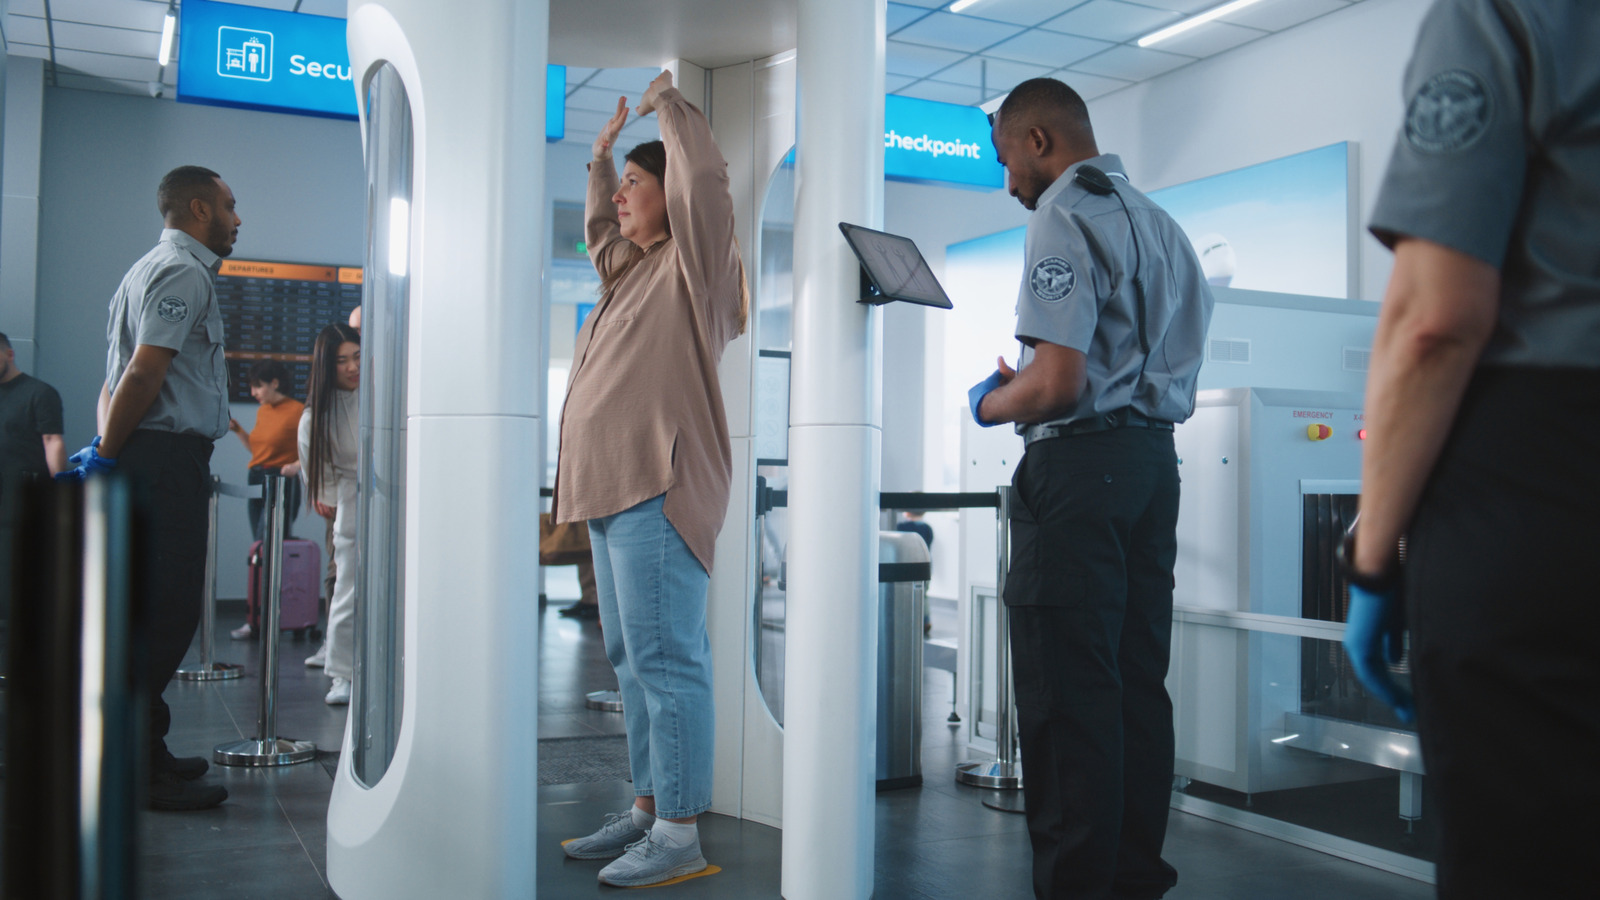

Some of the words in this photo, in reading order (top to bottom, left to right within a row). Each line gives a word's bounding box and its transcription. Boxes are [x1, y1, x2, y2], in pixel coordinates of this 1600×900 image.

[289, 54, 352, 81] Secu
[228, 264, 275, 275] DEPARTURES
[1292, 410, 1334, 420] EMERGENCY
